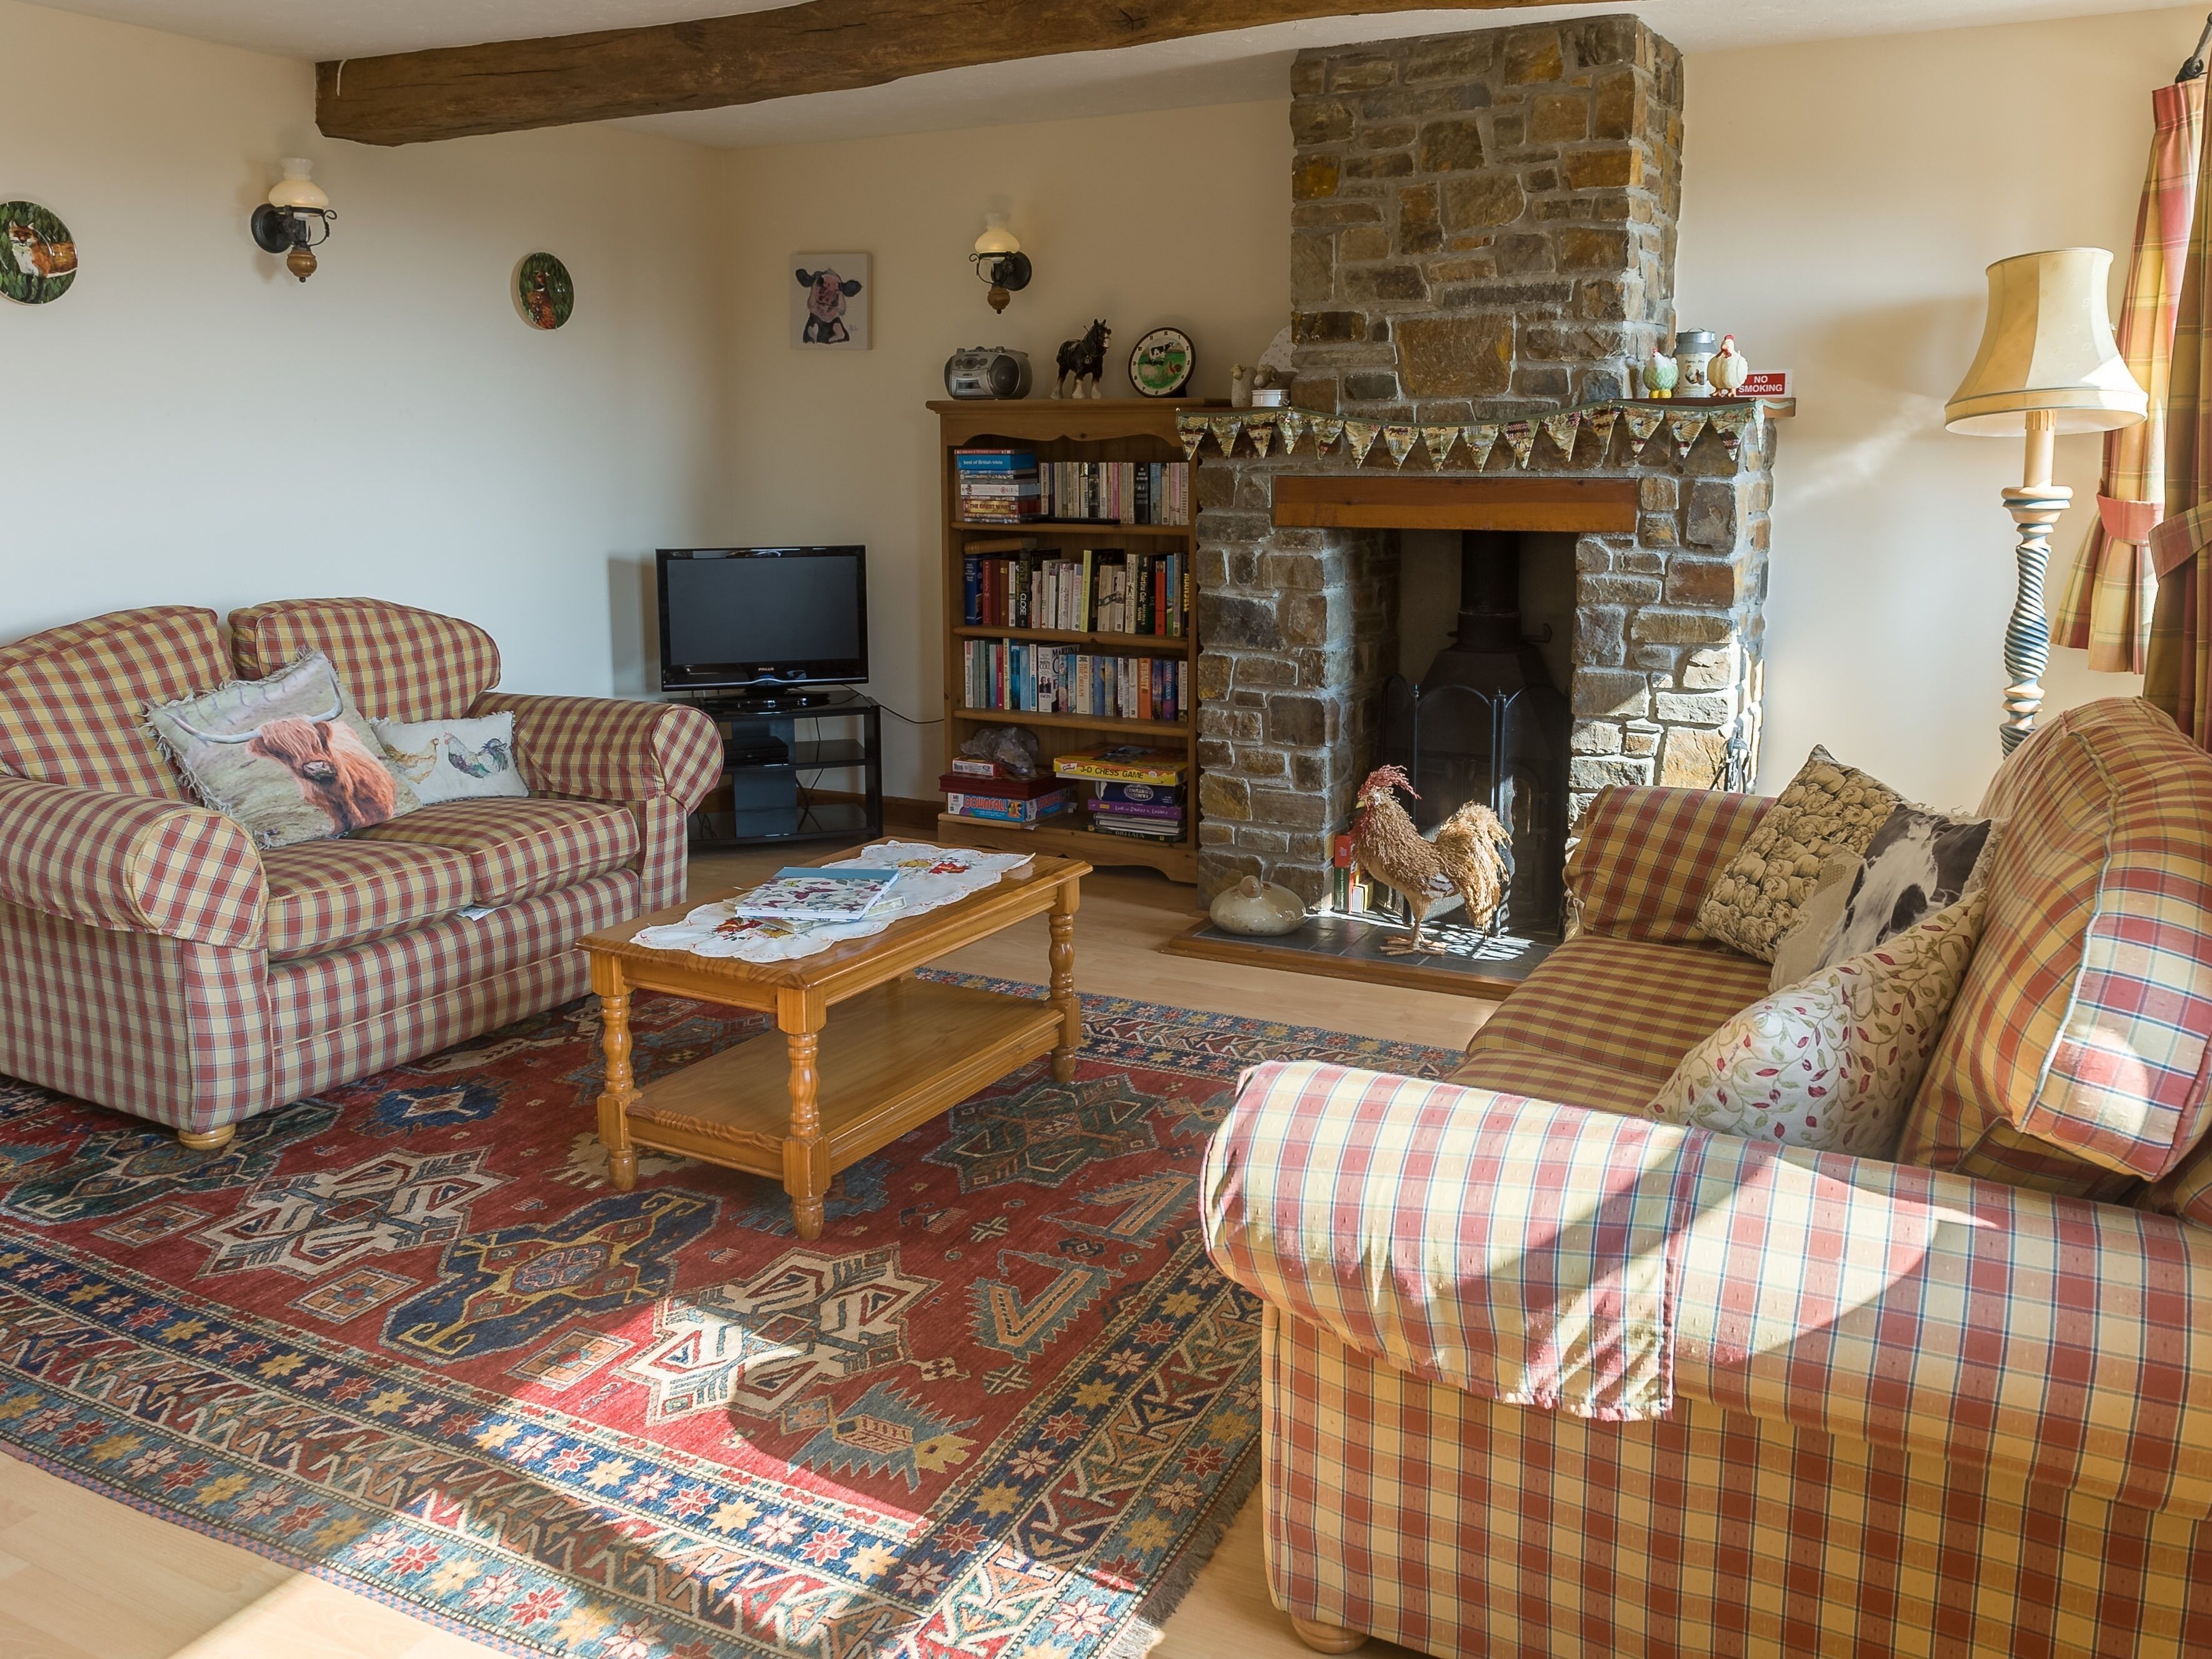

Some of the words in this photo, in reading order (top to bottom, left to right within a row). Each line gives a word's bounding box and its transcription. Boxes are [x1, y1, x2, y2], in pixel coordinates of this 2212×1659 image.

[1754, 375, 1768, 383] NO
[1739, 384, 1783, 393] SMOKING
[1095, 768, 1119, 776] CHESS
[1122, 770, 1143, 779] GAME
[964, 796, 1008, 811] DOWNFALL
